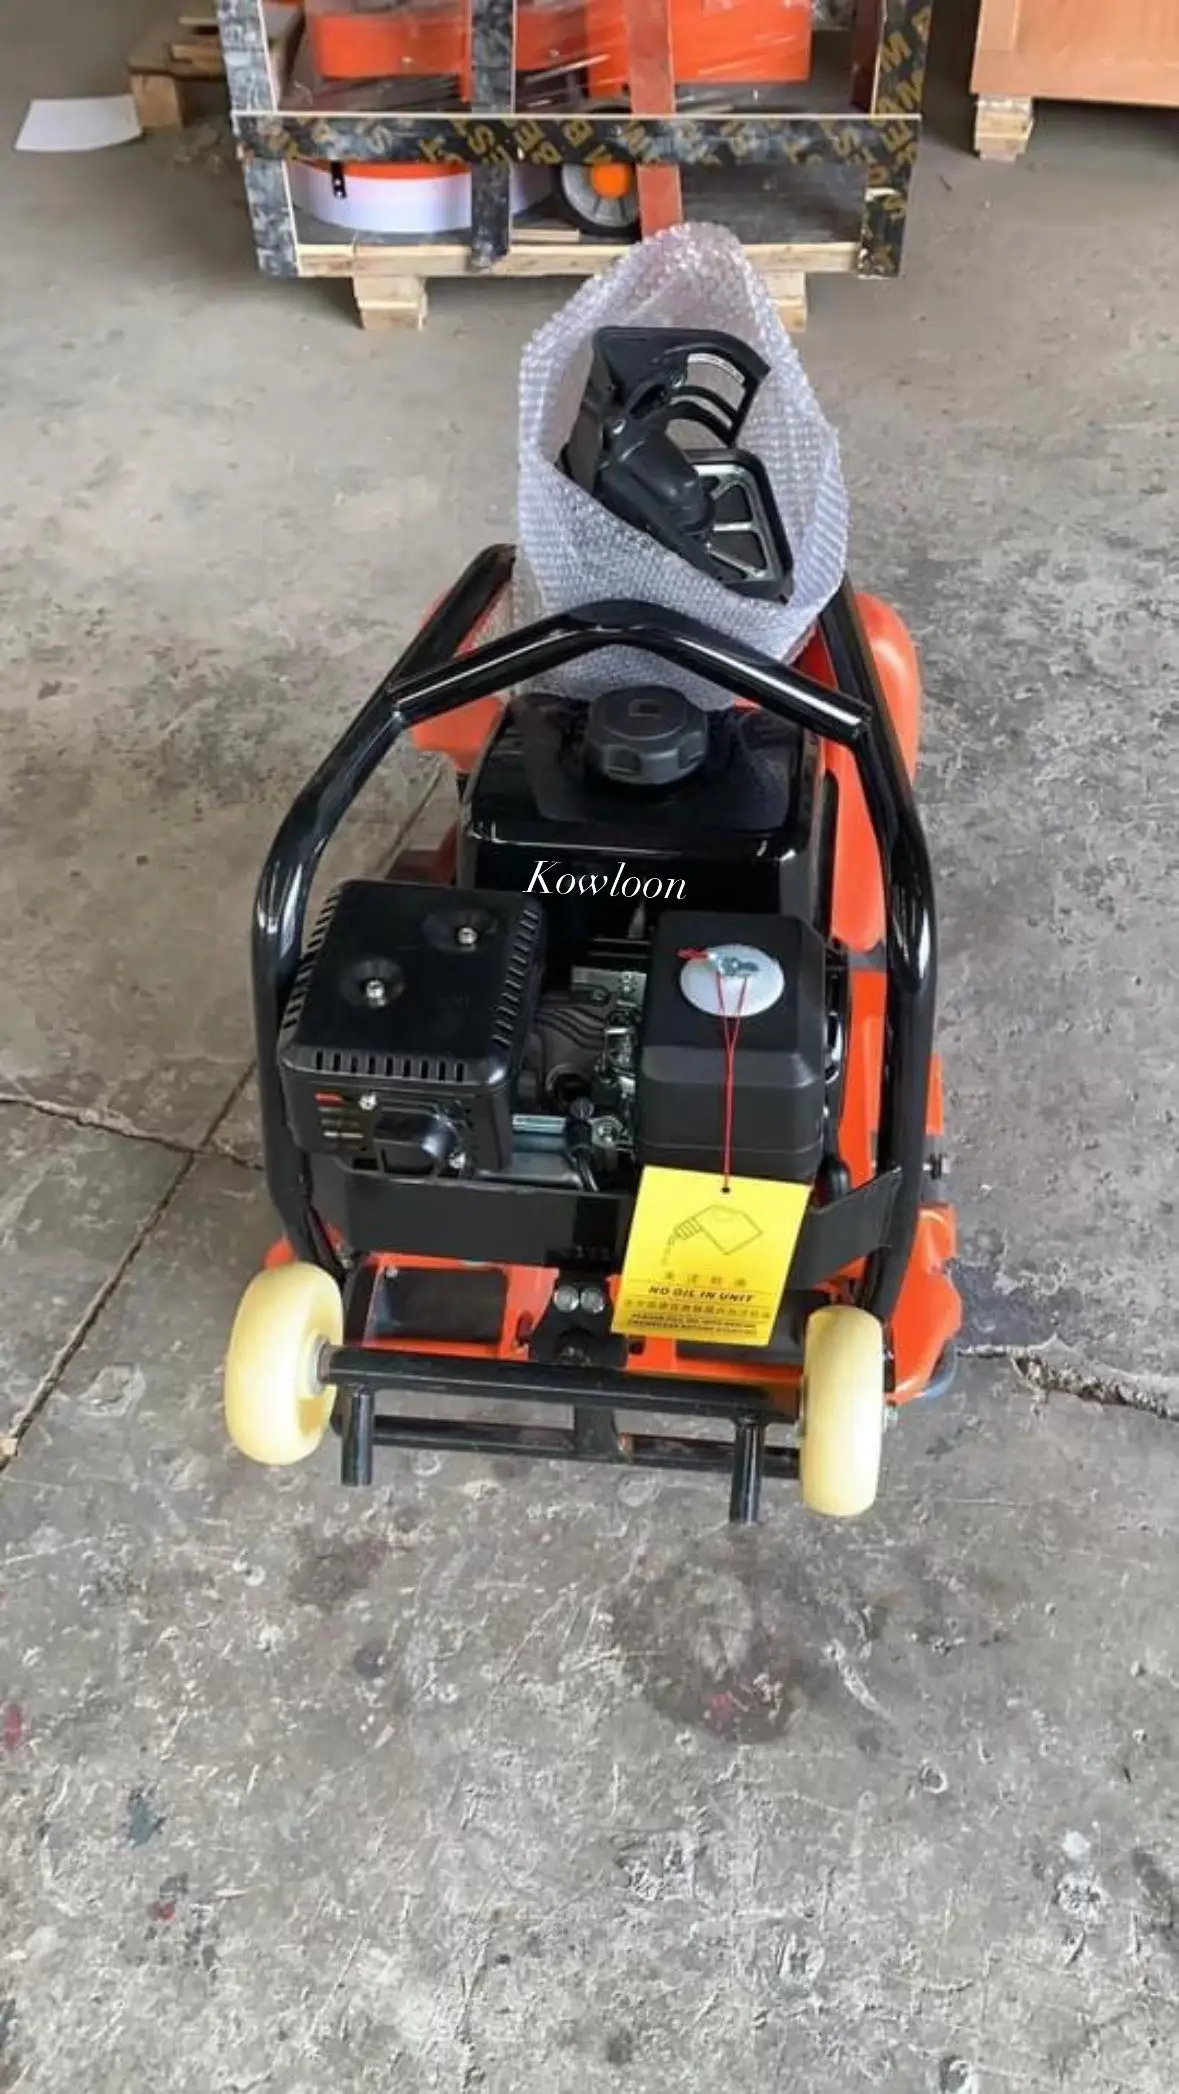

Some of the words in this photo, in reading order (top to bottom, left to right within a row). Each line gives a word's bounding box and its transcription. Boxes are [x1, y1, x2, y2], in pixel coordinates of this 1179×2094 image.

[648, 1285, 671, 1296] NO
[673, 1287, 696, 1298] OIL
[700, 1290, 718, 1300] IN
[719, 1292, 756, 1303] UNIT
